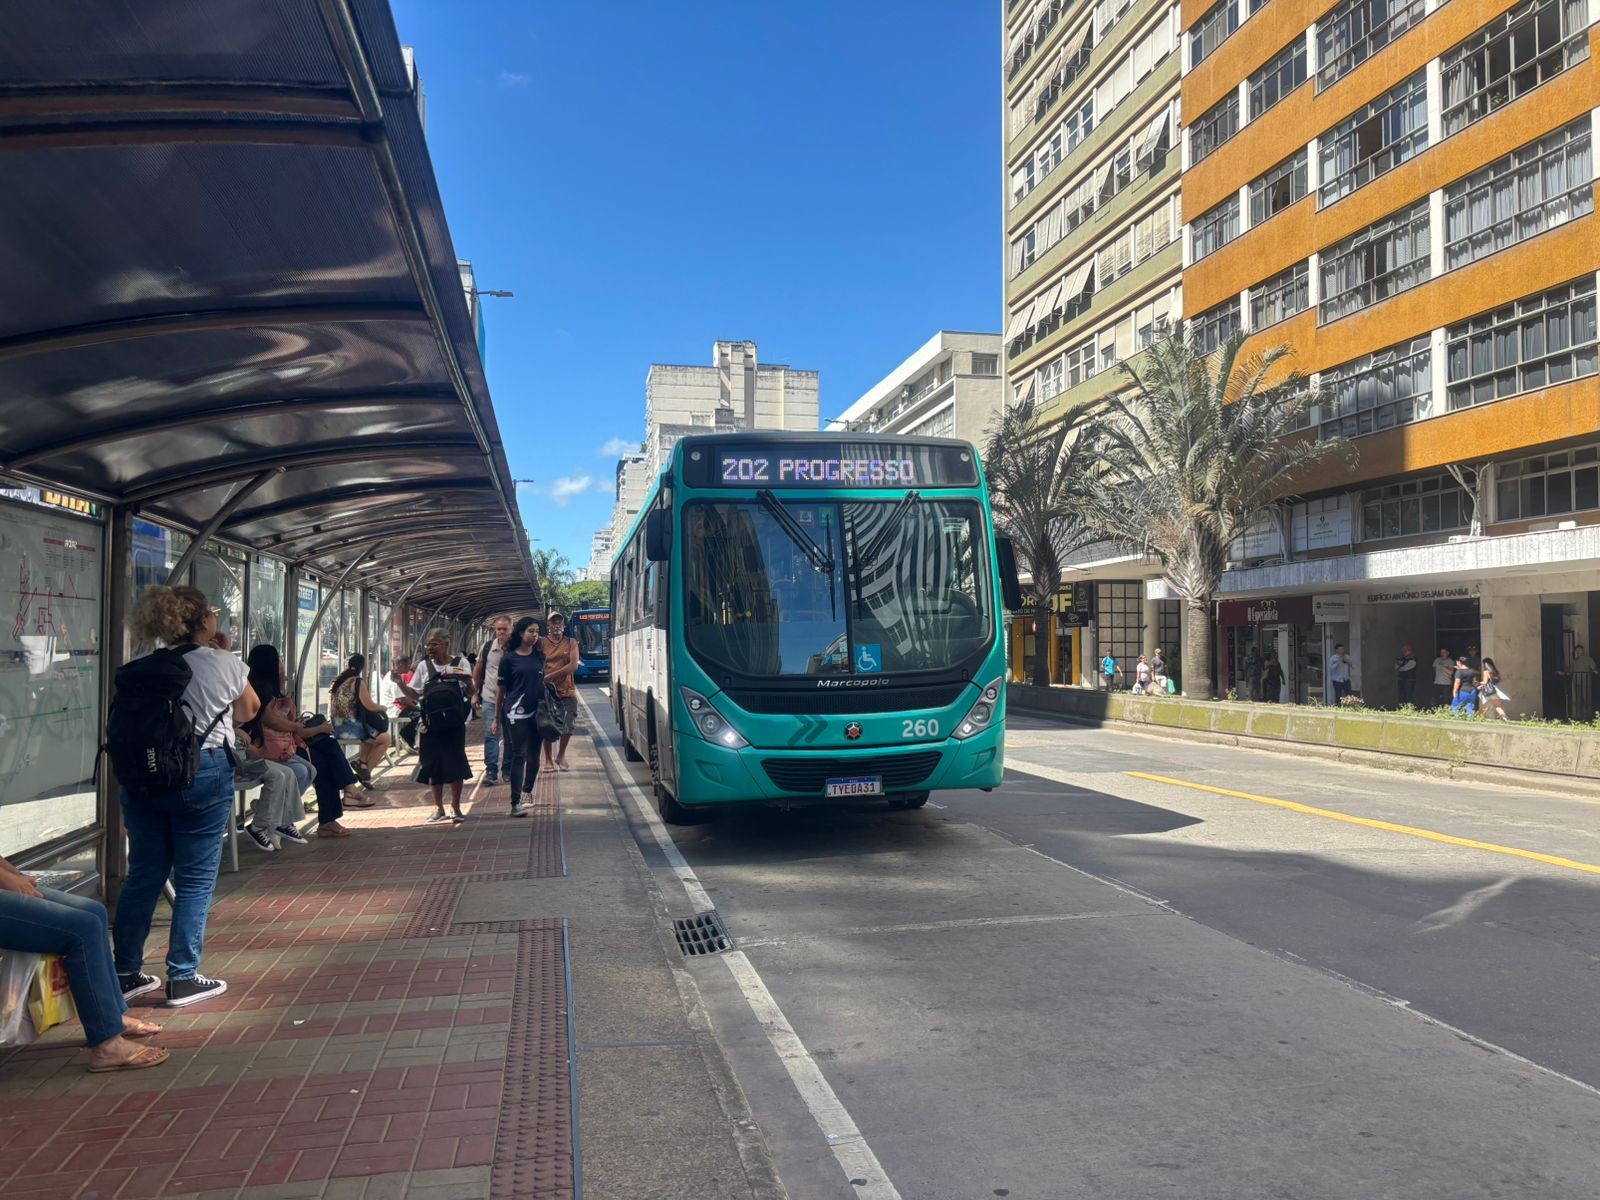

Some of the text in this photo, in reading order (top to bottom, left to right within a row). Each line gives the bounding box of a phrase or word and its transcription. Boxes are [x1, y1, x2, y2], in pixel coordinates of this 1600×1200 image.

[721, 458, 915, 481] 202 PROGRESSO
[1392, 590, 1419, 601] ANTÔNIO
[817, 678, 890, 688] Marcopolo
[902, 718, 940, 739] 260
